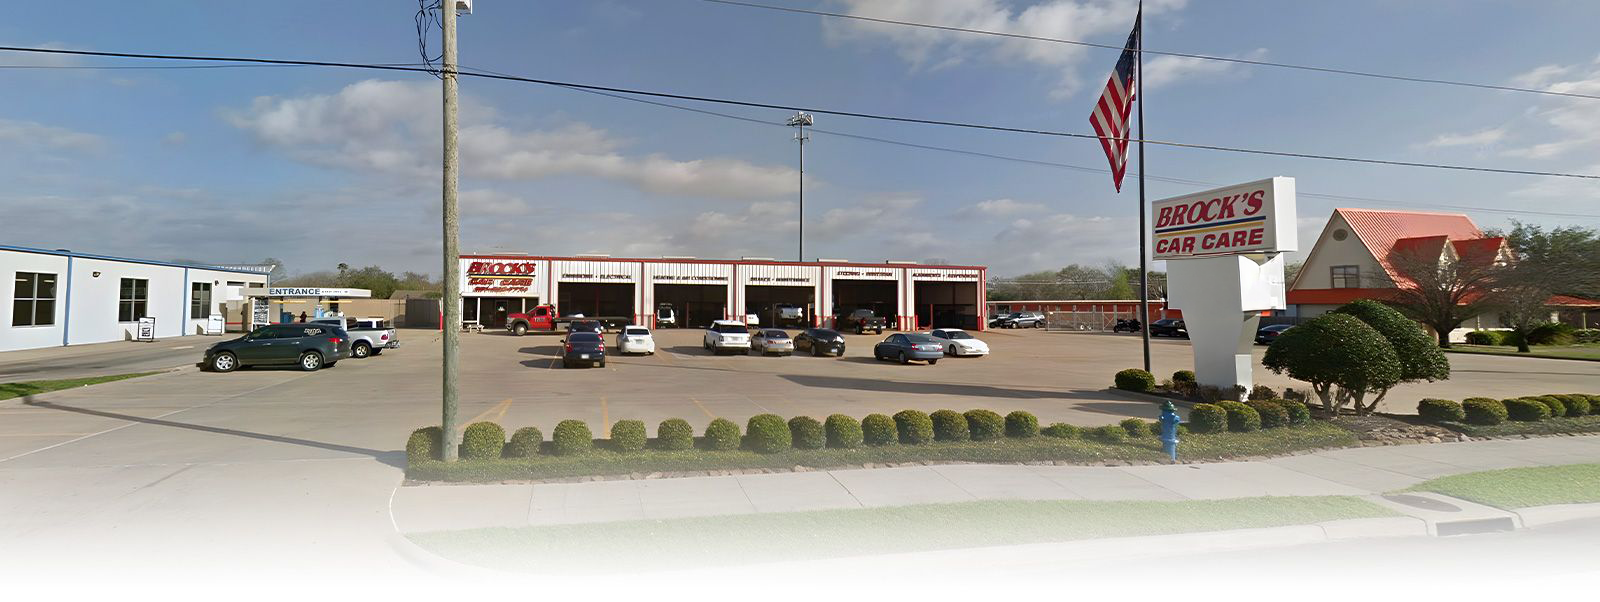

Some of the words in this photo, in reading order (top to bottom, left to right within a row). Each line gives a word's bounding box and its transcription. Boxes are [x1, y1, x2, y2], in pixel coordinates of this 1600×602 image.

[1155, 190, 1265, 229] BROCK'S
[1156, 236, 1196, 254] CAR
[1201, 227, 1265, 250] CARE
[269, 288, 321, 296] ENTRANCE
